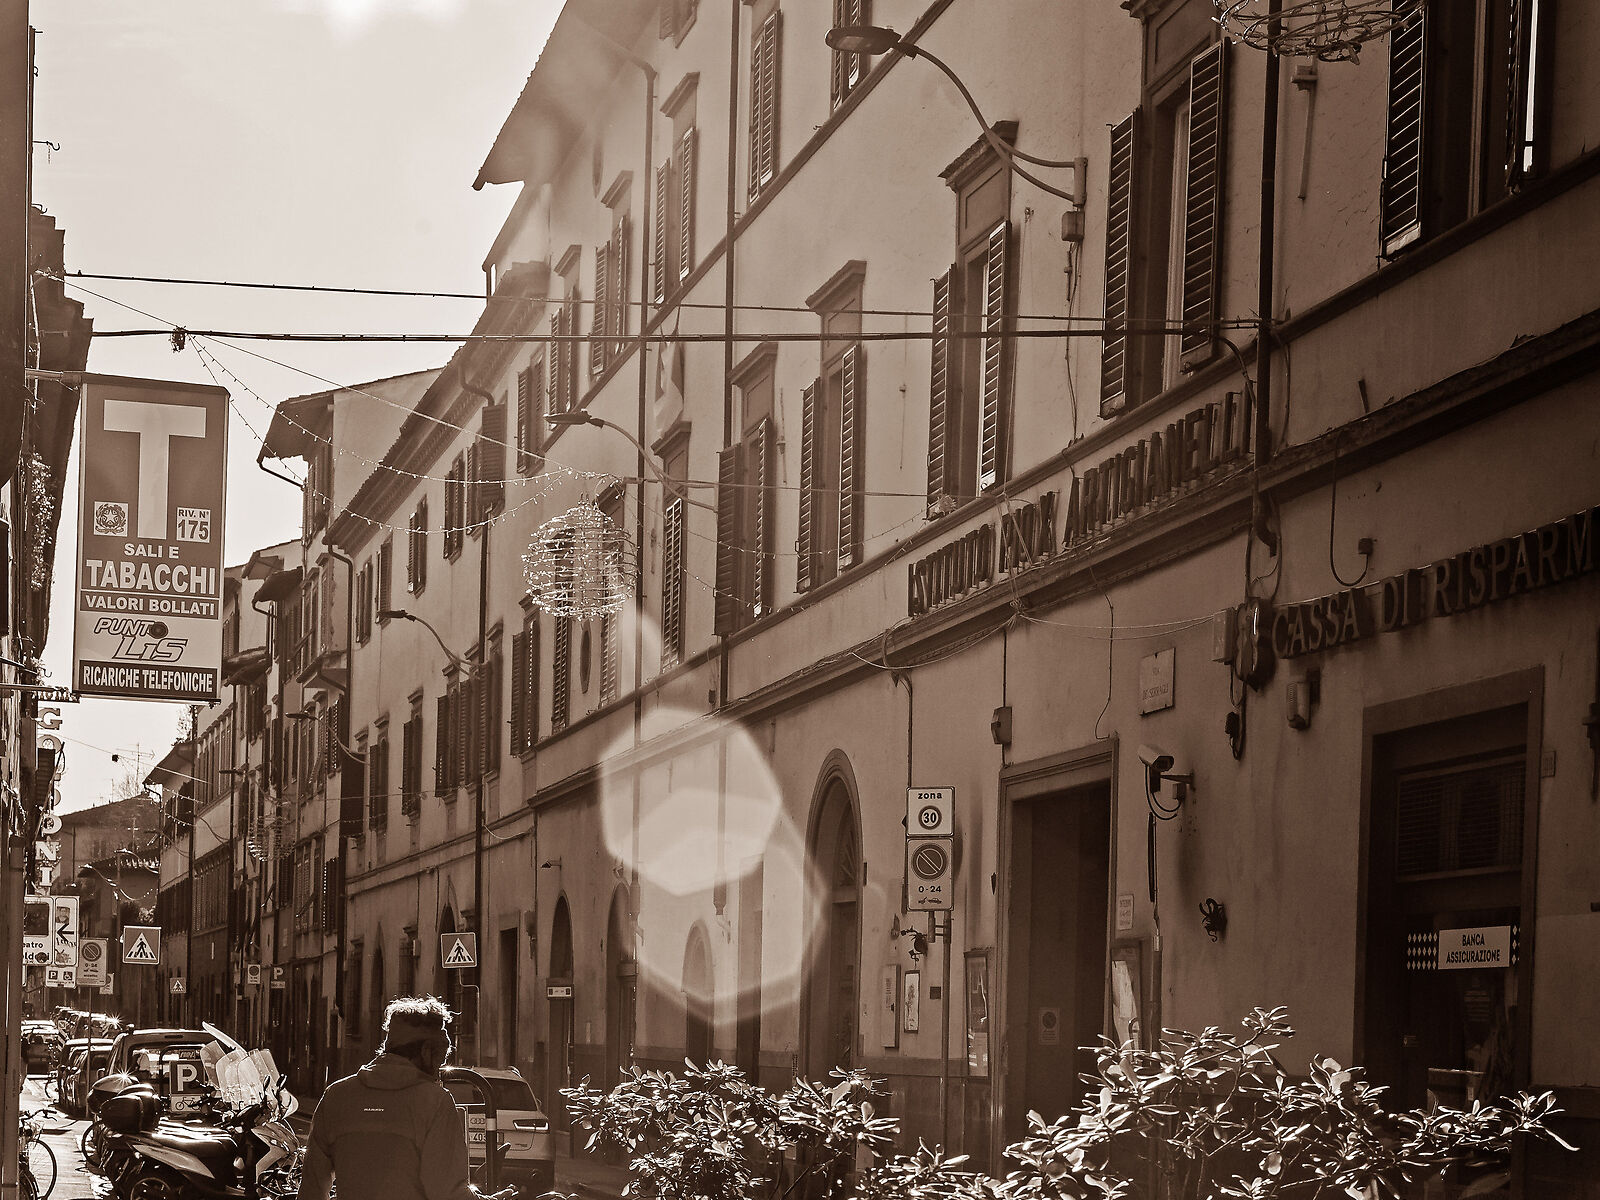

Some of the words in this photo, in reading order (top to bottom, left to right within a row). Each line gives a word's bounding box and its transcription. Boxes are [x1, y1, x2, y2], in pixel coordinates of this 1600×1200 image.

[103, 399, 207, 540] T
[178, 509, 197, 518] RIV.
[177, 520, 209, 541] 175
[124, 543, 163, 559] SALI
[168, 546, 179, 559] E
[86, 559, 216, 595] TABACCHI
[85, 595, 144, 611] VALORI
[148, 599, 215, 616] BOLLATI
[1271, 588, 1362, 660] CASSA
[1380, 569, 1413, 632] DI
[94, 617, 169, 639] PUNTO
[83, 665, 140, 688] RICARICHE
[142, 669, 213, 693] TELEFONICHE
[917, 791, 943, 800] zona
[923, 811, 937, 825] 30
[23, 941, 44, 949] eatro
[1462, 933, 1485, 947] BANCA
[1446, 949, 1501, 964] ASSICURAZIONE
[50, 971, 57, 980] P
[273, 967, 284, 980] P
[176, 1063, 198, 1092] P
